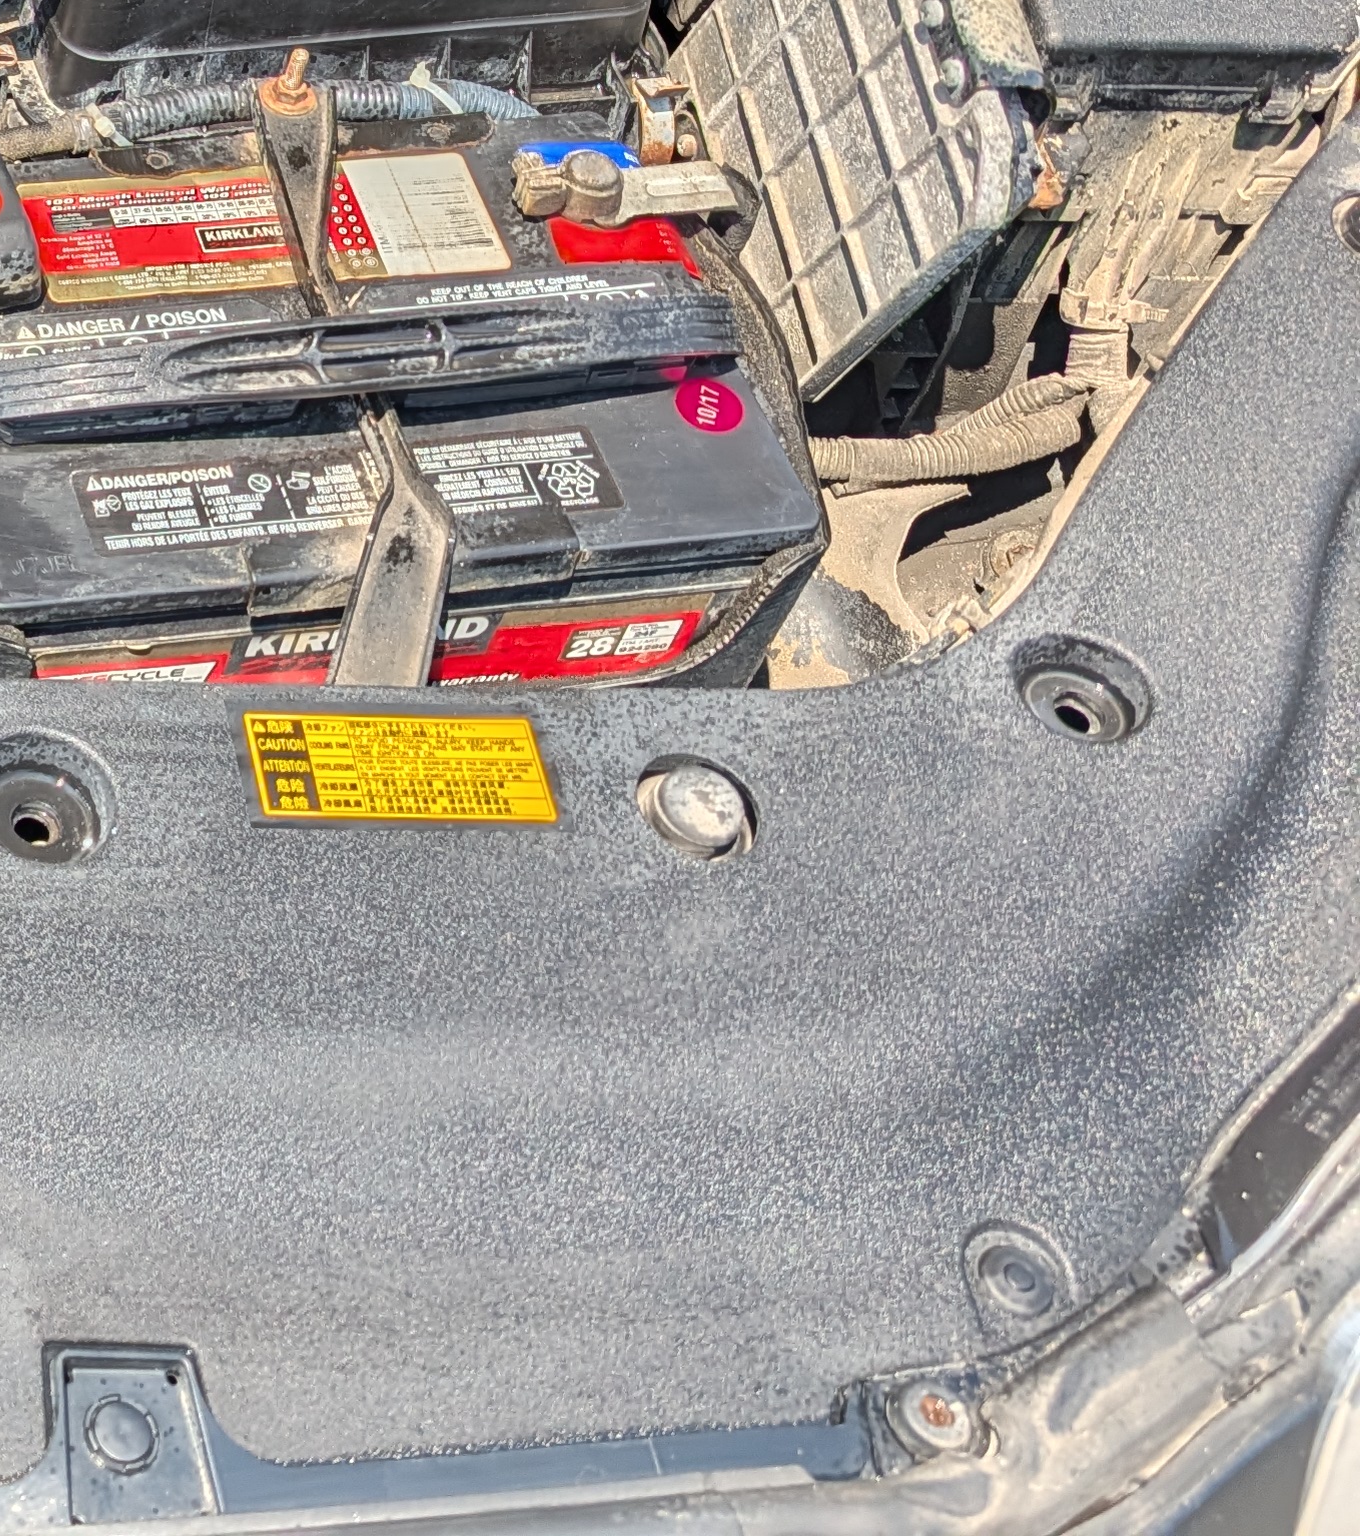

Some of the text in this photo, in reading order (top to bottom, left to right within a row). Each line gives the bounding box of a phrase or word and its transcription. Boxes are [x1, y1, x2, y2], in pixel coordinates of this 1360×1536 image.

[45, 198, 74, 206] 100
[78, 193, 131, 203] Month
[204, 226, 284, 242] KIRKLAND
[415, 297, 429, 305] DO
[431, 295, 448, 304] NOT
[469, 291, 490, 299] KEEP
[491, 289, 513, 298] VENT
[514, 287, 538, 296] CAPS
[540, 284, 564, 293] TIGHT
[565, 282, 583, 290] AND
[584, 279, 610, 288] LEVEL
[430, 275, 589, 296] KEEP OUT OF THE REACH OF CHILDREN
[37, 317, 126, 340] DANGER
[145, 307, 228, 328] POISON
[695, 385, 720, 425] 10/17
[100, 465, 234, 490] DANGER/POISON
[463, 471, 476, 480] LES
[476, 469, 494, 479] YEUX
[159, 488, 173, 499] LES
[173, 486, 192, 497] YEUX
[124, 497, 194, 511] LES GAZ EXPLOSIFS
[105, 540, 131, 551] TENIR
[131, 538, 154, 548] HORS
[155, 536, 165, 546] DE
[166, 535, 179, 545] LA
[179, 531, 210, 544] PORTÉE
[210, 530, 228, 541] DES
[267, 524, 280, 536] NE
[281, 522, 297, 534] PAS
[566, 637, 615, 658] 28
[257, 738, 306, 751] CAUTION
[263, 759, 311, 772] ATTENTION
